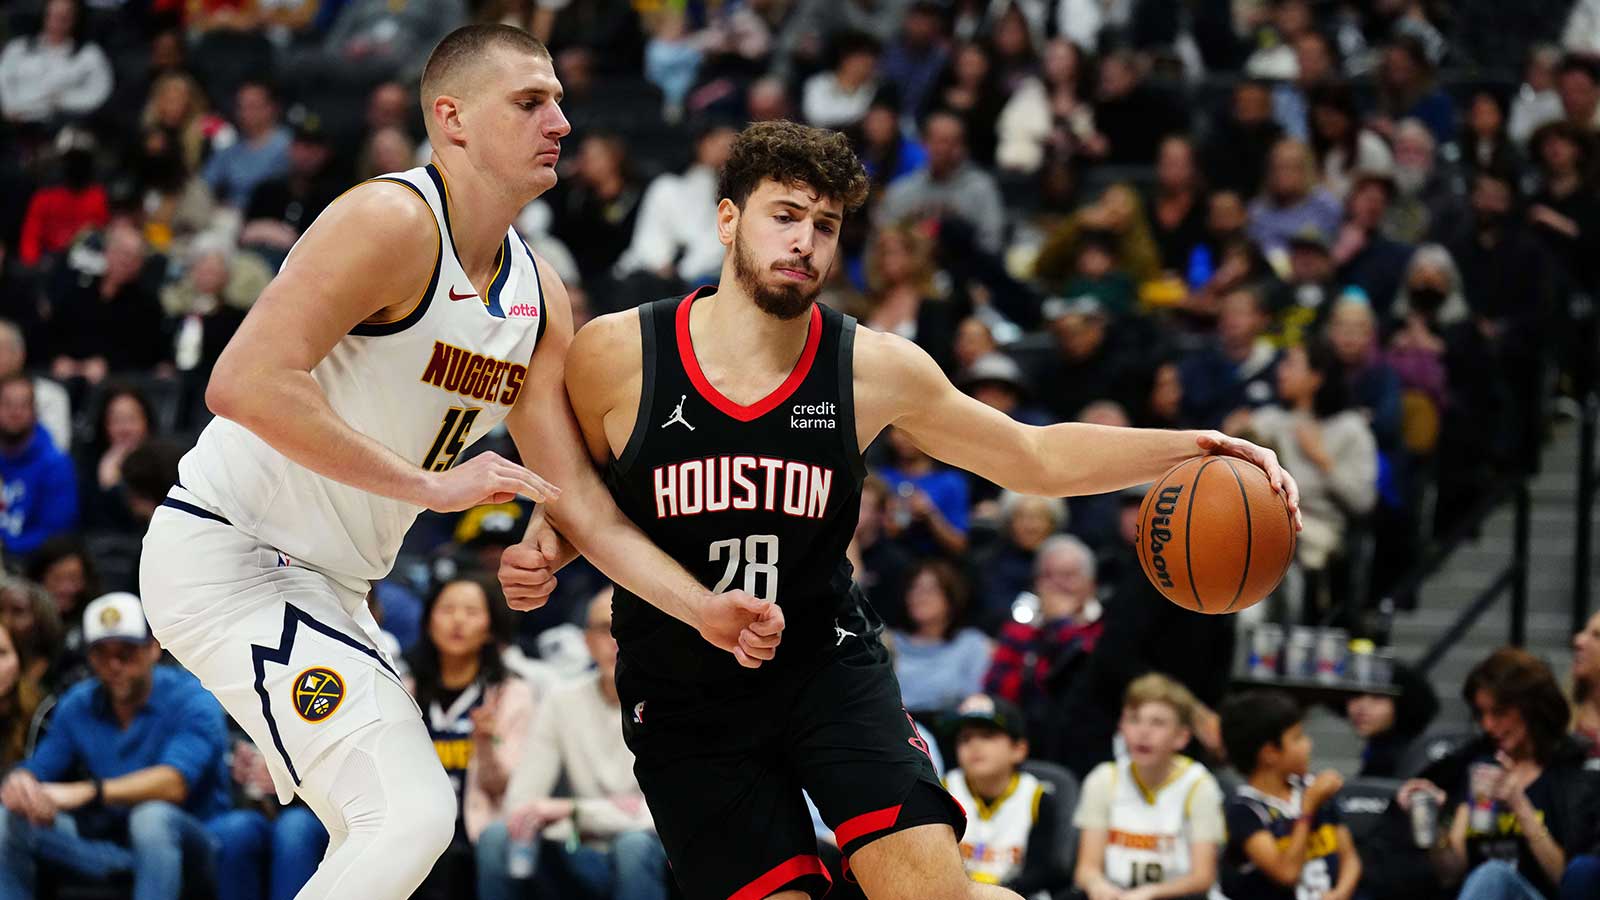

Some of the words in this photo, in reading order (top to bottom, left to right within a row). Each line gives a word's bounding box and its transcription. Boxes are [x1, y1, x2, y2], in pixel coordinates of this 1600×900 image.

[420, 340, 528, 406] NUGGETS
[790, 416, 836, 429] karma
[793, 402, 836, 415] credit
[653, 456, 834, 519] HOUSTON
[1150, 484, 1184, 588] Wilson
[708, 534, 779, 604] 28
